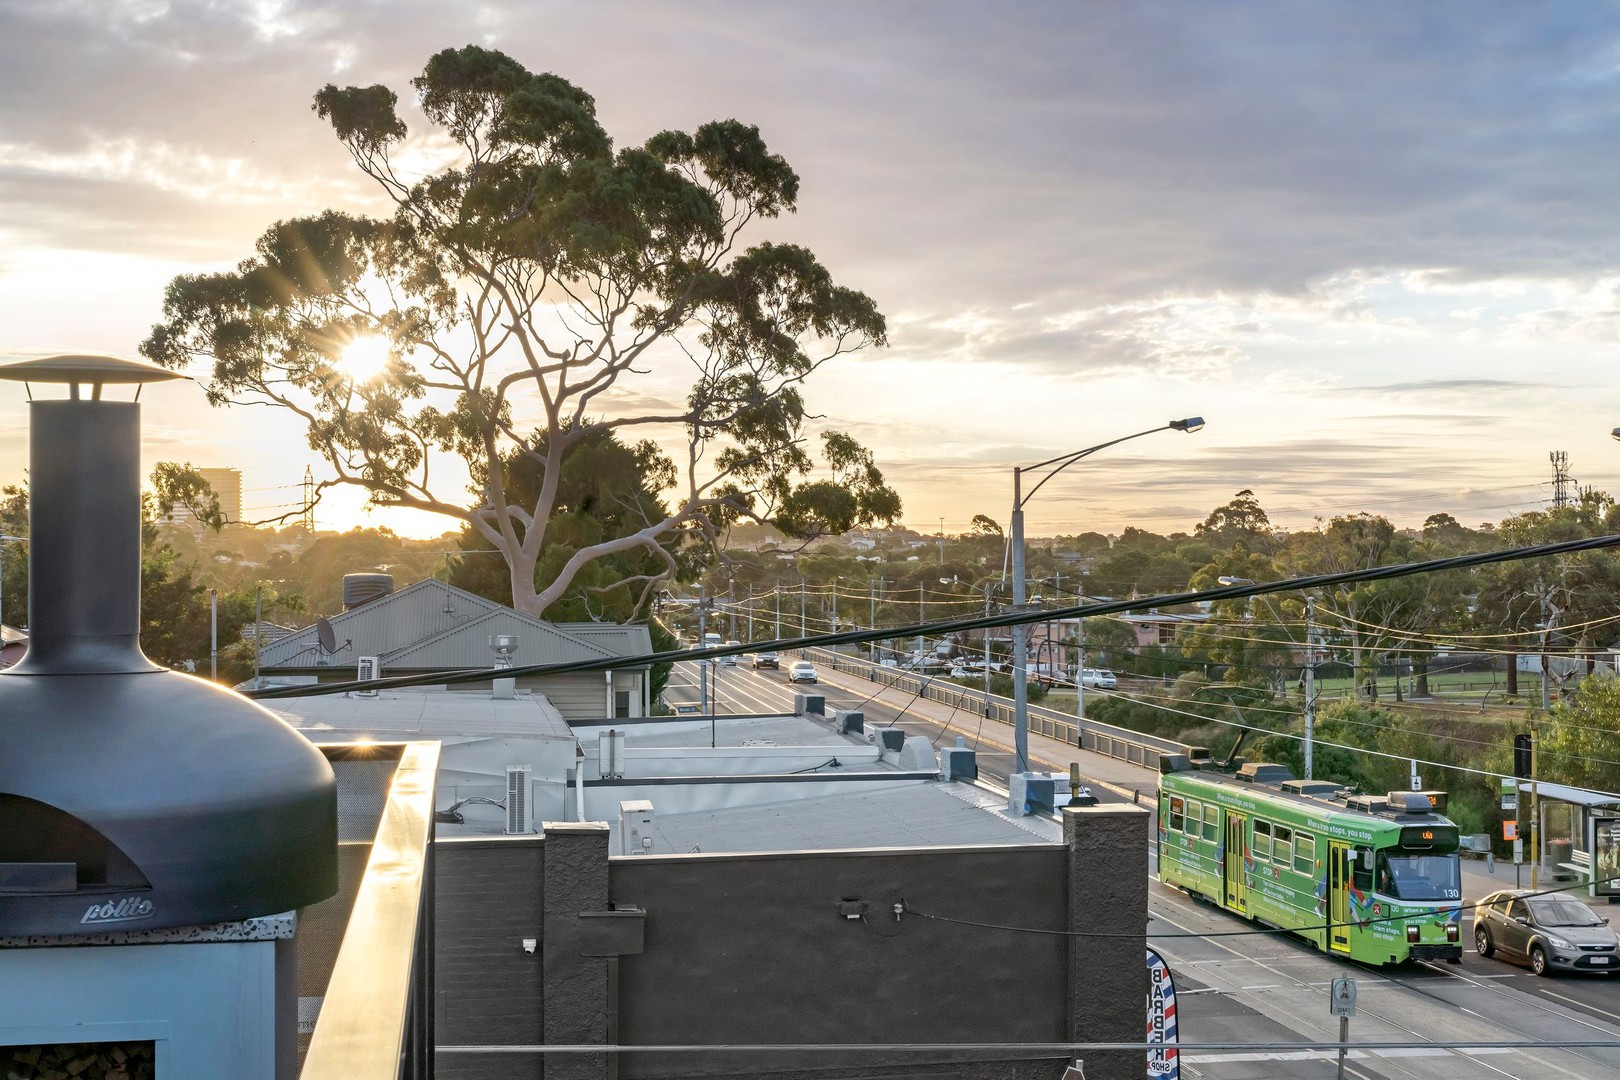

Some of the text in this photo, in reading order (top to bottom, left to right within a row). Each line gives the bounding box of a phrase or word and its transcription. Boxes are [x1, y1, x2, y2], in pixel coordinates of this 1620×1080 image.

[1307, 818, 1317, 828] When
[1320, 822, 1329, 832] tram
[1329, 825, 1347, 836] stops,
[1347, 829, 1358, 838] you
[1358, 831, 1373, 842] stop.
[1262, 866, 1273, 877] STOP
[1443, 888, 1459, 898] 130
